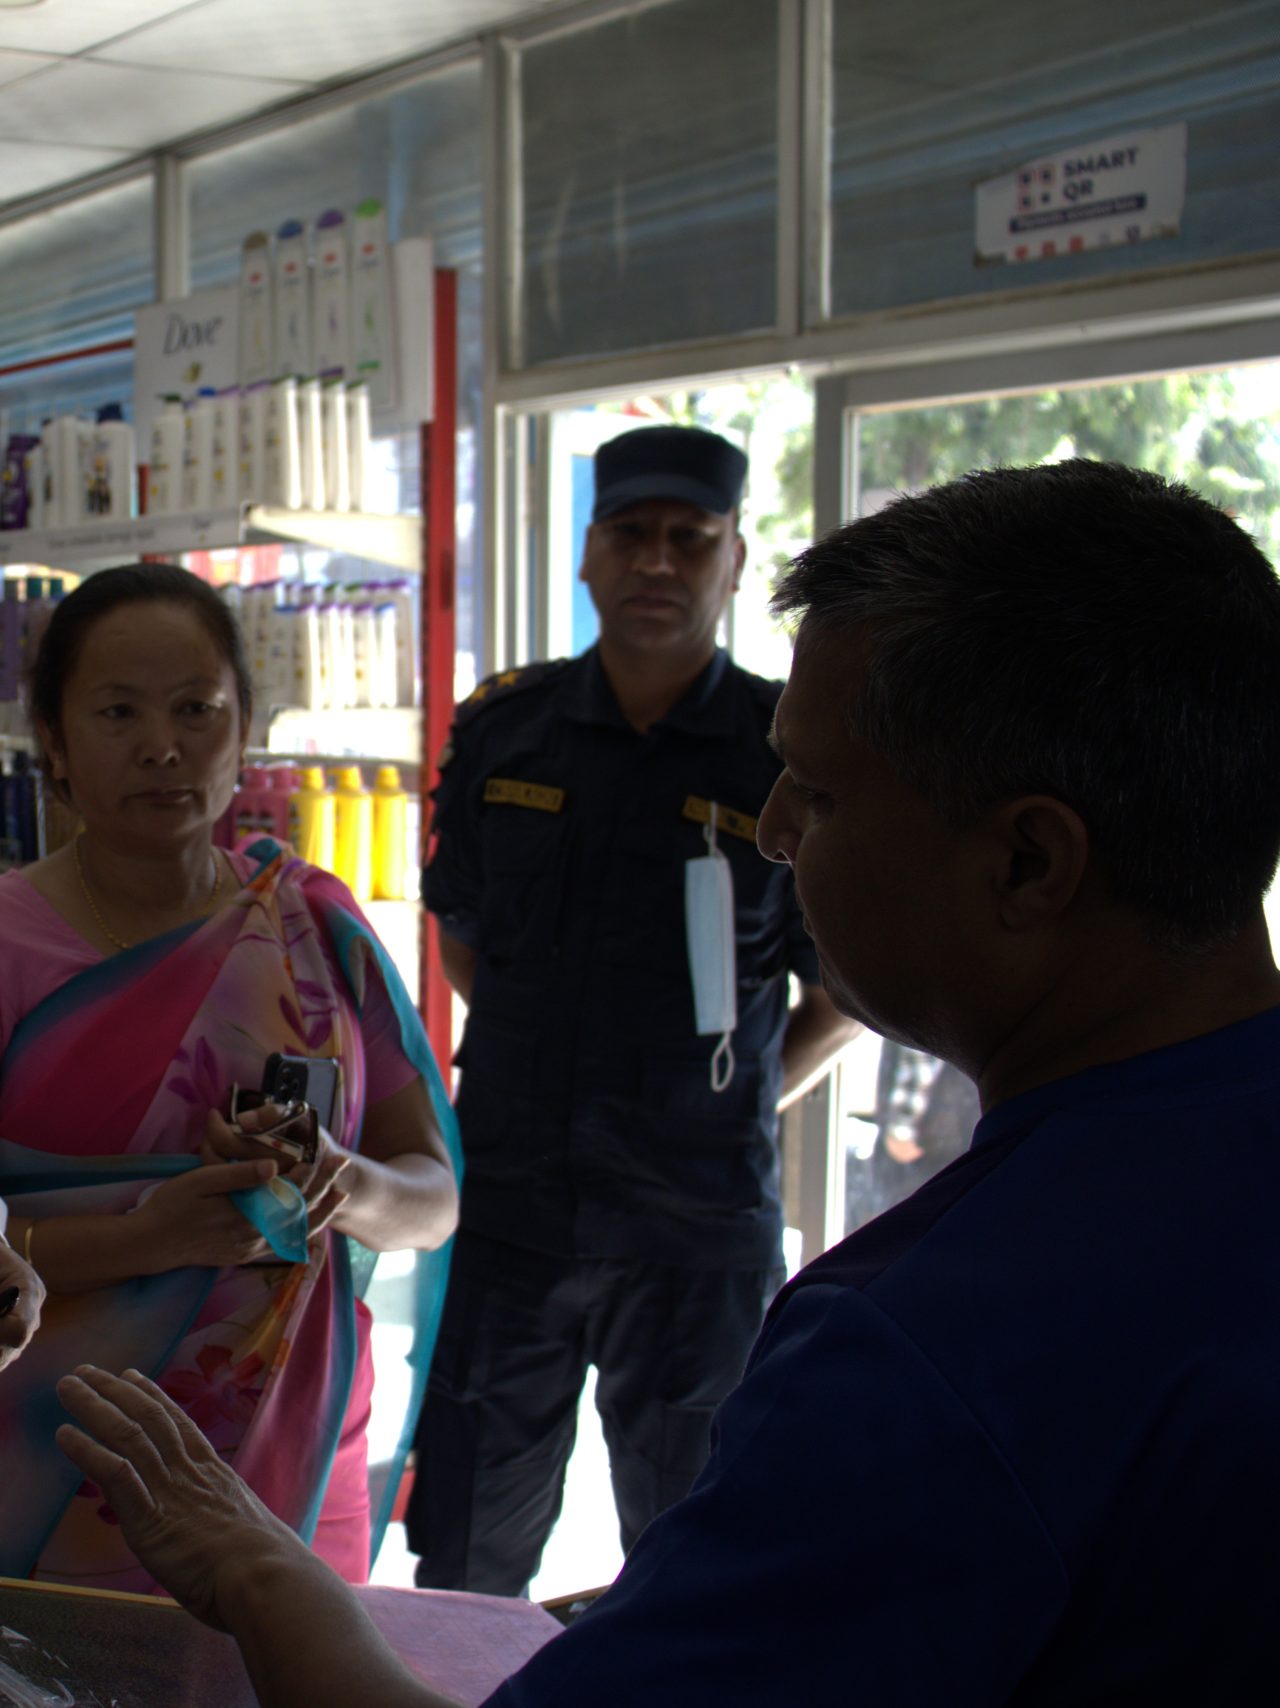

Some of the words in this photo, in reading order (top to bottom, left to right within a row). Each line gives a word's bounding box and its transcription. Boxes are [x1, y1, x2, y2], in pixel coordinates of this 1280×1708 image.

[1063, 147, 1138, 177] SMART
[1064, 179, 1094, 201] QR
[161, 312, 224, 356] Dove
